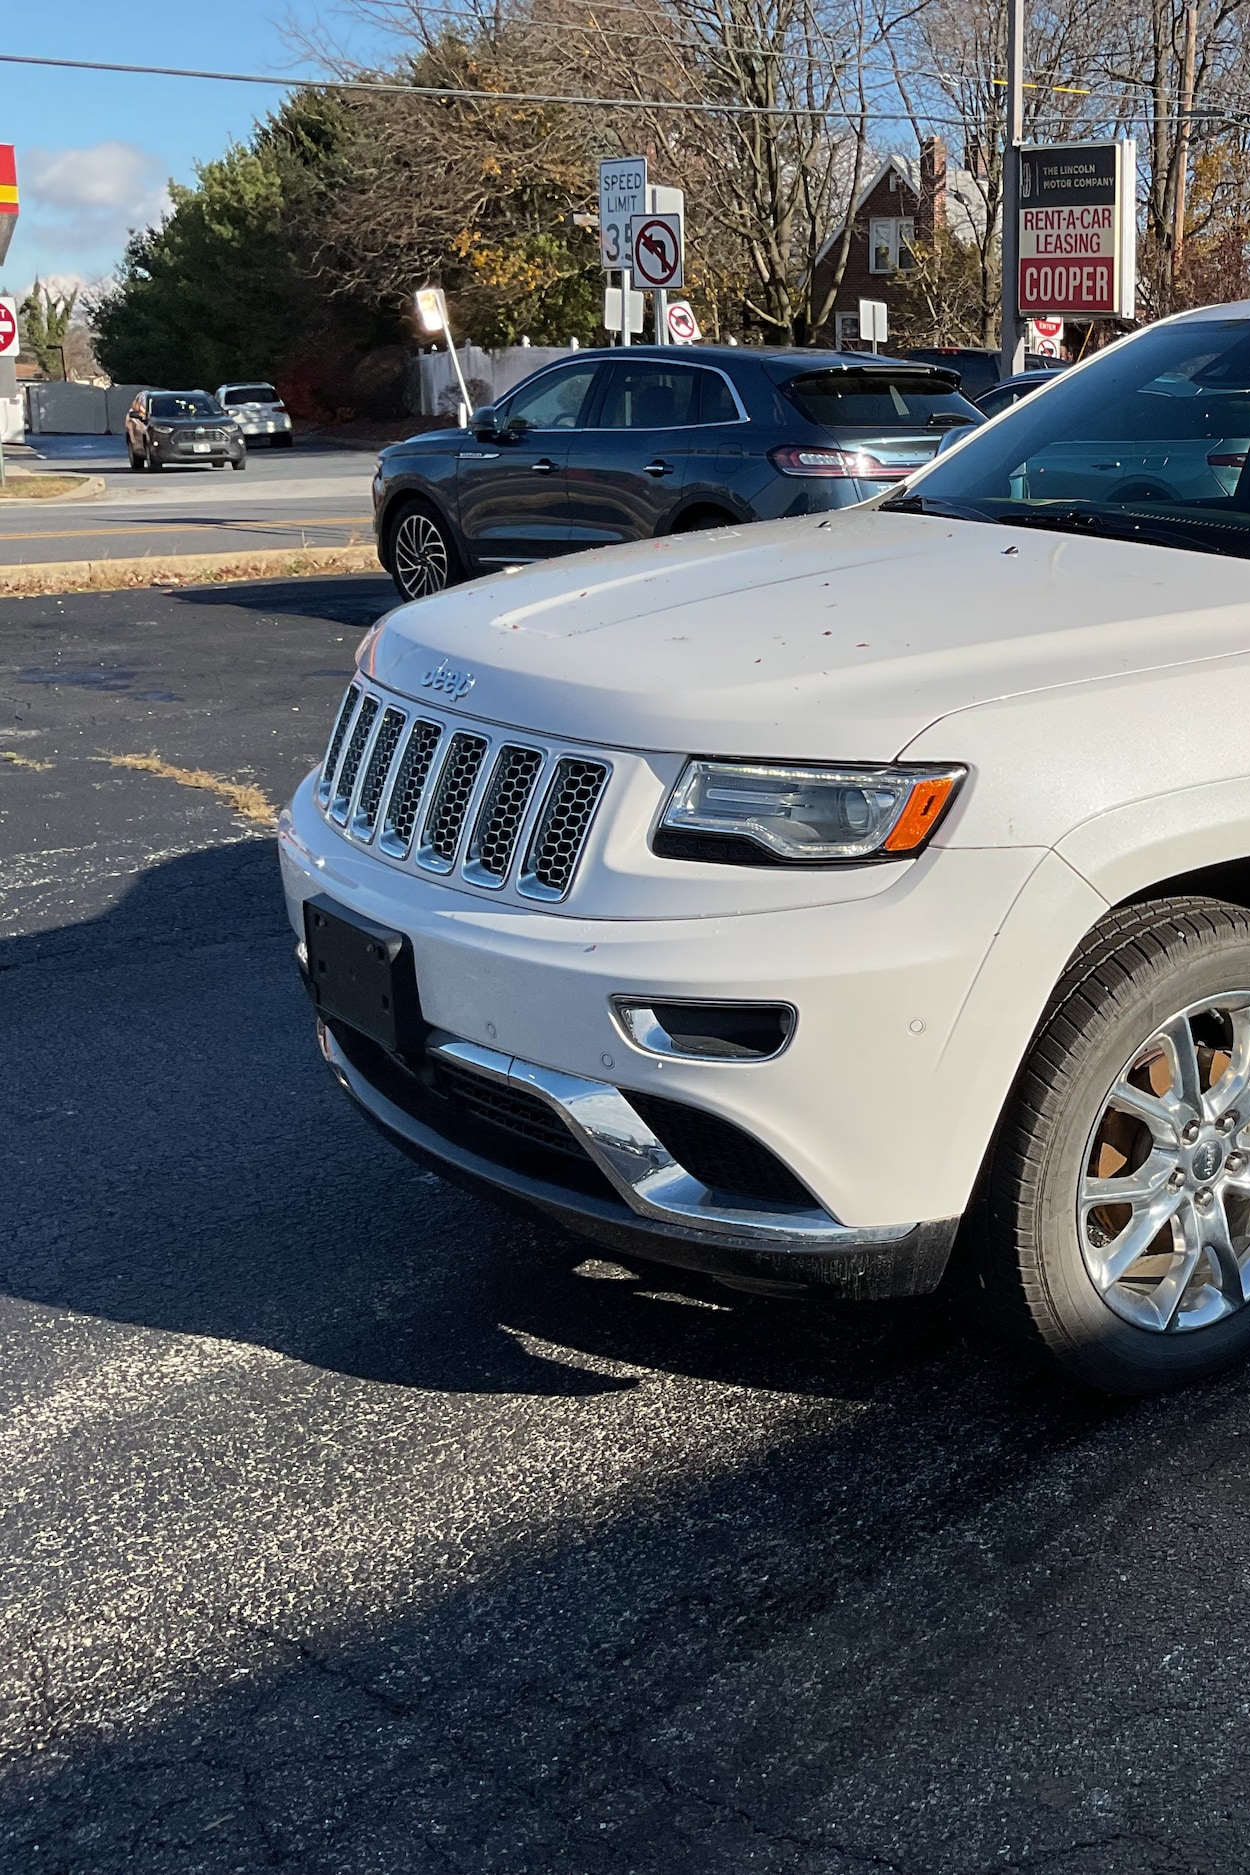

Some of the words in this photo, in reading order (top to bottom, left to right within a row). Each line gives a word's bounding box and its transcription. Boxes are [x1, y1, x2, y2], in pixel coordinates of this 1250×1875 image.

[1042, 166, 1059, 176] THE
[1060, 164, 1096, 175] LINCOLN
[603, 173, 642, 191] SPEED
[1043, 179, 1072, 189] MOTOR
[1073, 177, 1114, 188] COMPANY
[607, 195, 637, 213] LIMIT
[1024, 208, 1111, 231] RENT-A-CAR
[1036, 233, 1100, 254] LEASING
[1025, 266, 1108, 302] COOPER
[1039, 322, 1057, 331] ENTER
[420, 658, 476, 702] Jeep
